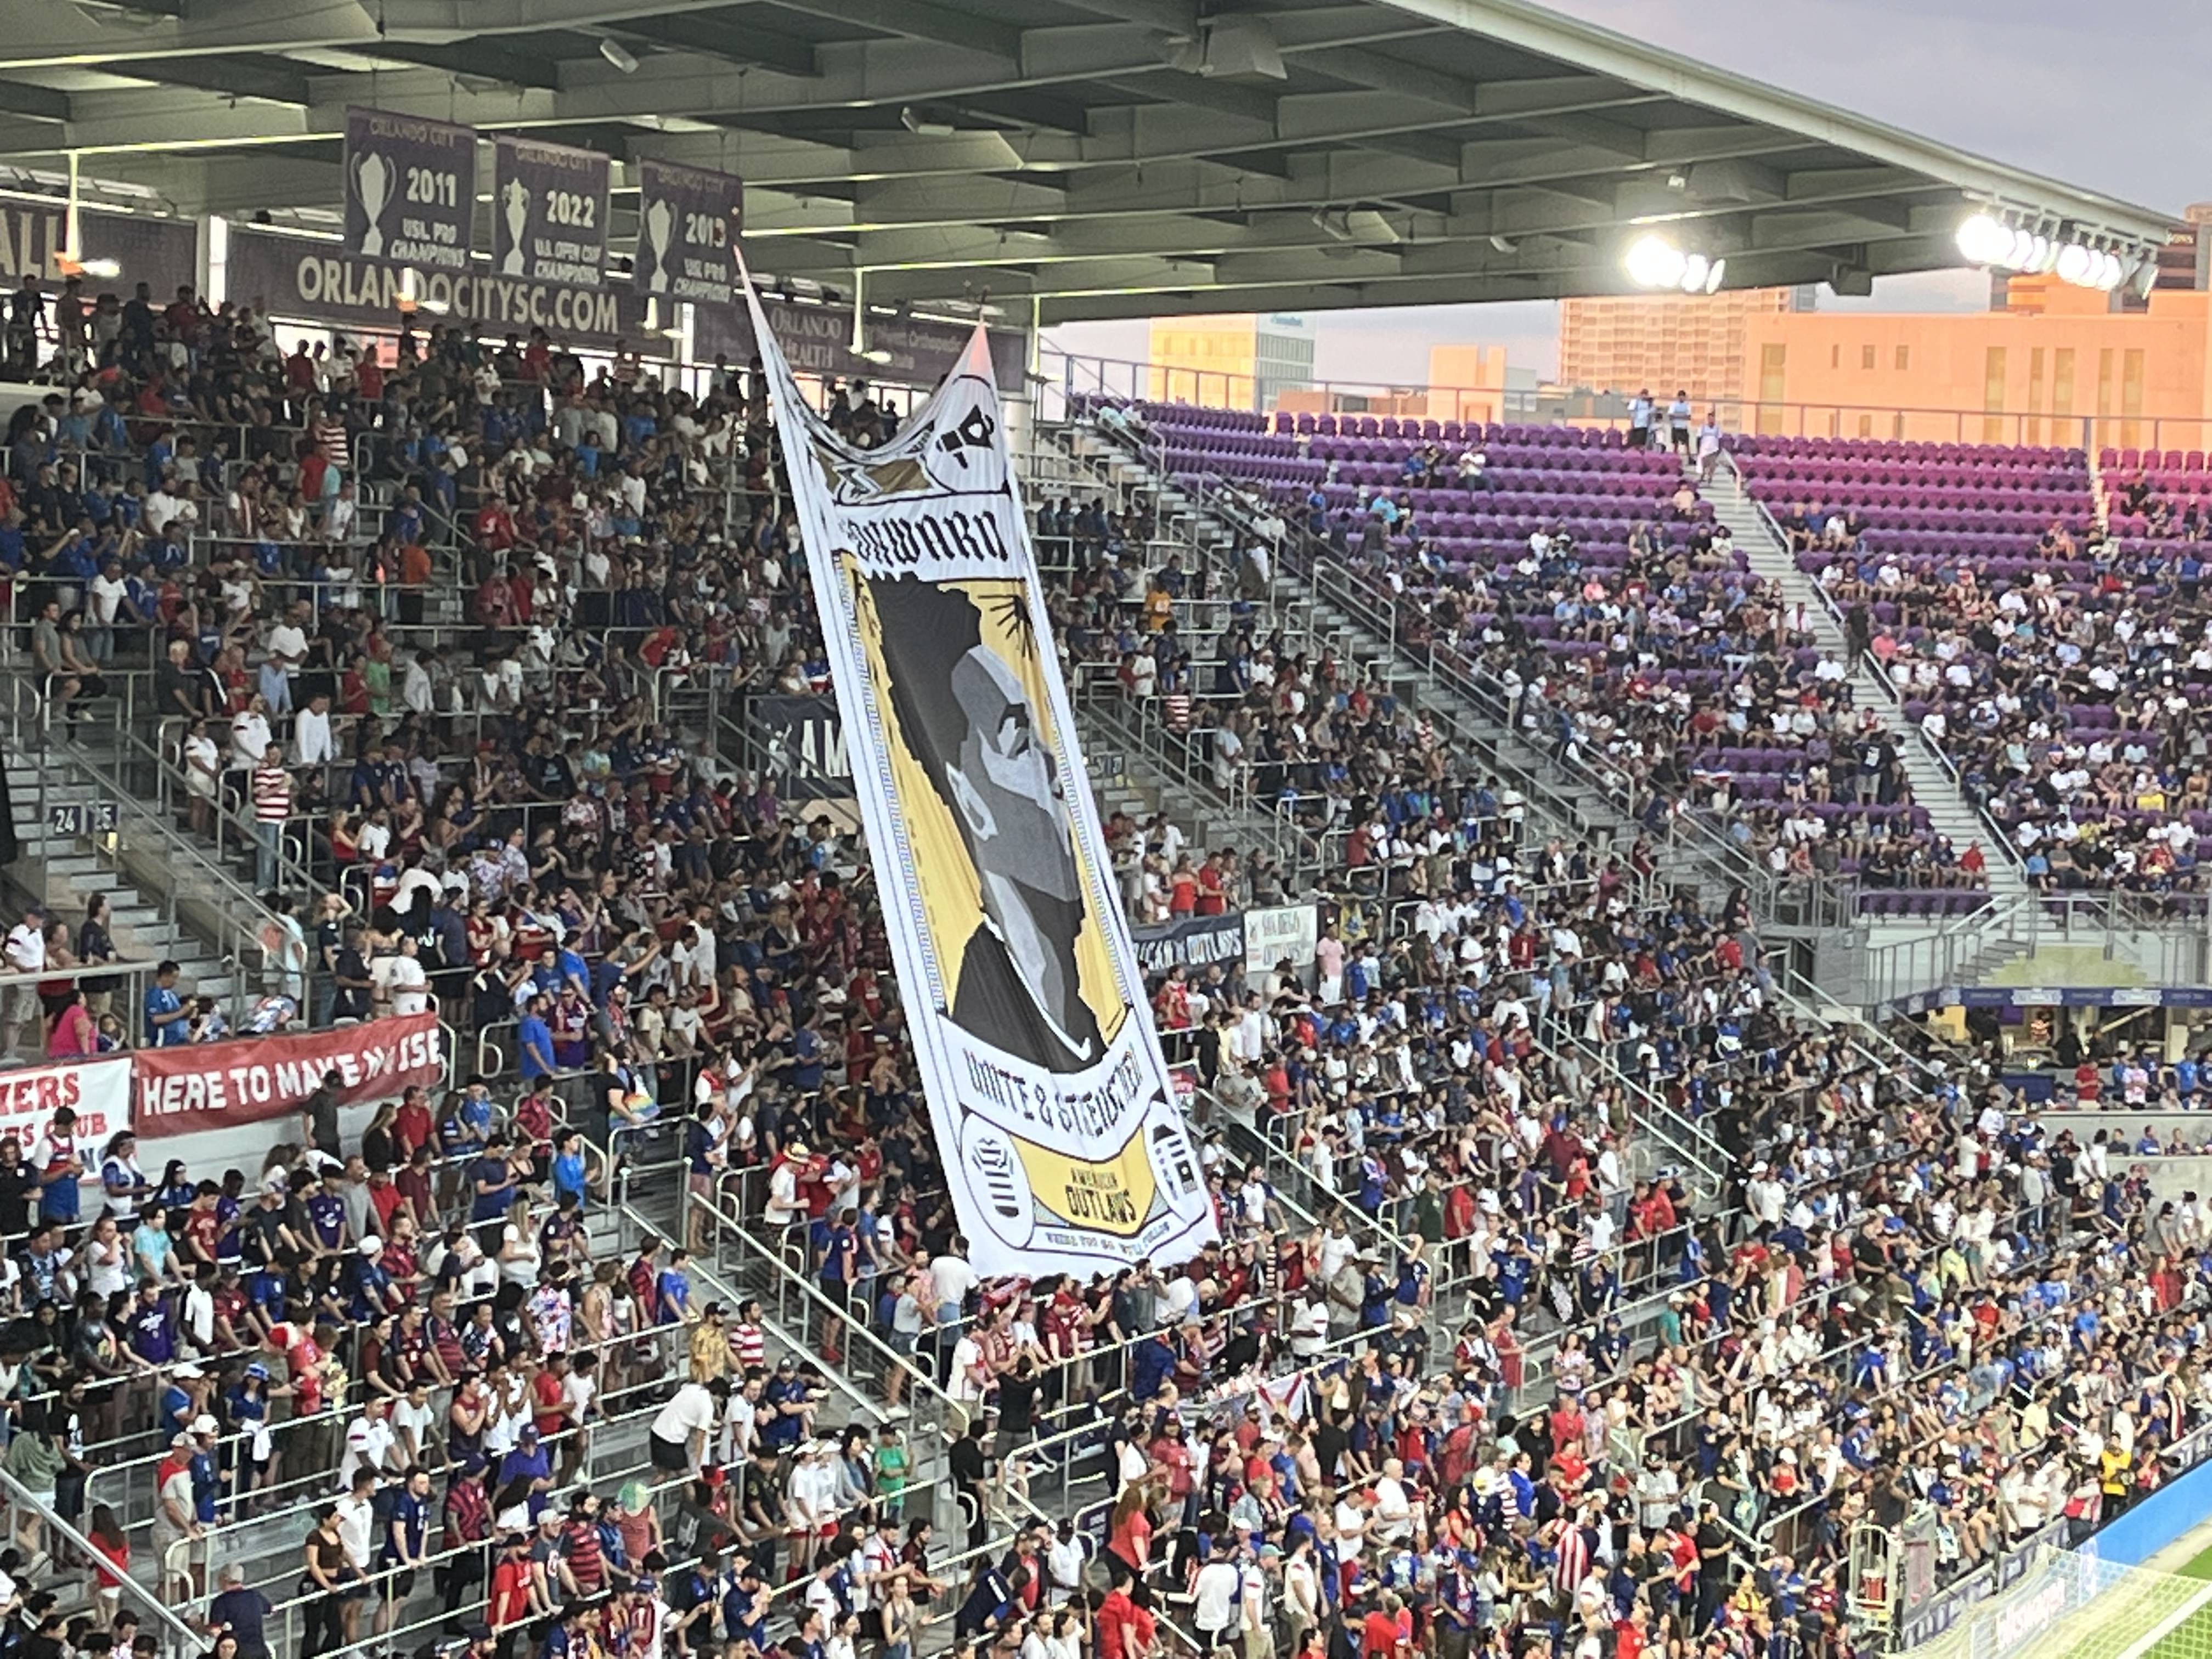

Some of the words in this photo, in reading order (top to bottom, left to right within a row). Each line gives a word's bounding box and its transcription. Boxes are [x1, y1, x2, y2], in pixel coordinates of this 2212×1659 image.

[407, 167, 456, 207] 2011
[547, 190, 595, 228] 2022
[433, 222, 457, 244] PRO
[390, 239, 466, 268] CHAMPIONS
[297, 256, 619, 335] ORLANDOCITYSC.COM
[770, 307, 842, 339] ORLANDO
[142, 1071, 227, 1116] HERE
[229, 1065, 270, 1105] TO
[1065, 1184, 1137, 1224] OUTLAWS
